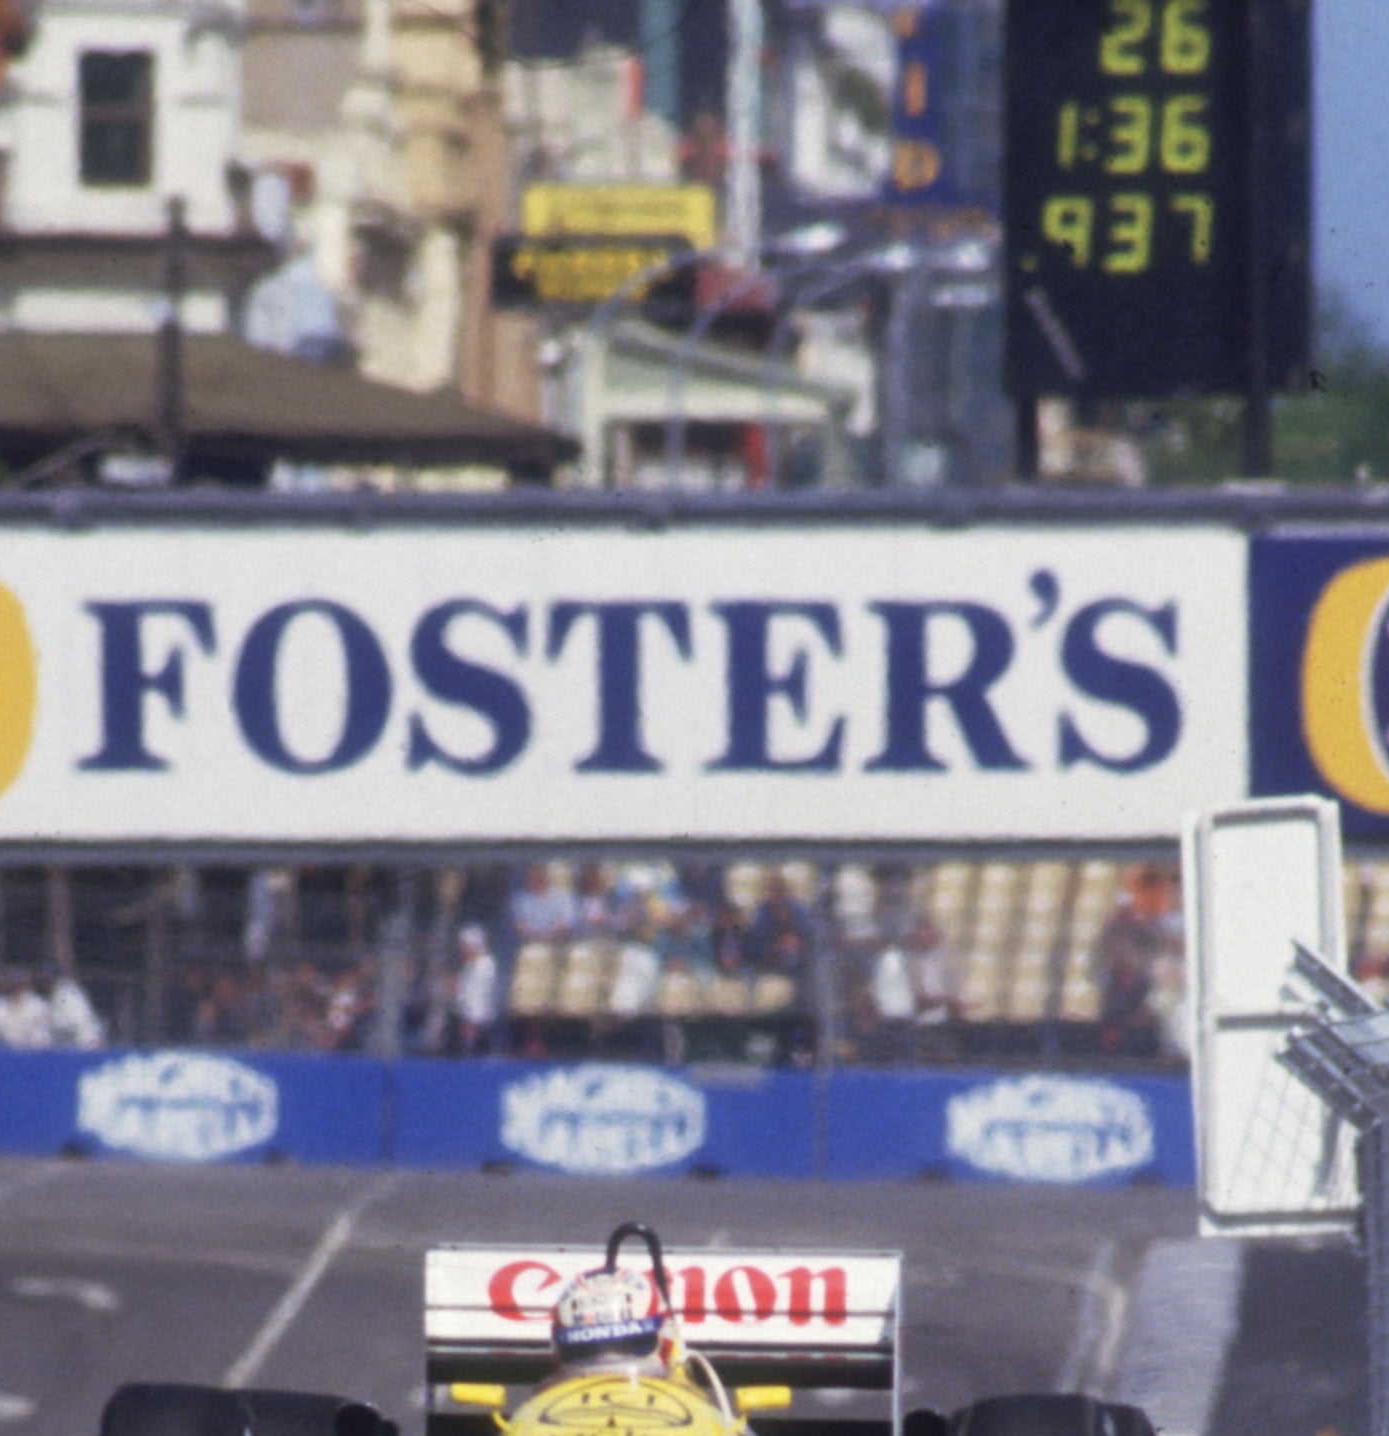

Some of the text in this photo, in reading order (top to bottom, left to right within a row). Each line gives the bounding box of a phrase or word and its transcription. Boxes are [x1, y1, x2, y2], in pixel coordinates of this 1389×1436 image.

[1100, 0, 1210, 75] 26
[1056, 95, 1210, 172] 1:36
[76, 568, 1185, 776] FOSTER'S
[488, 1260, 848, 1326] Cnon
[566, 1321, 644, 1344] HONDA
